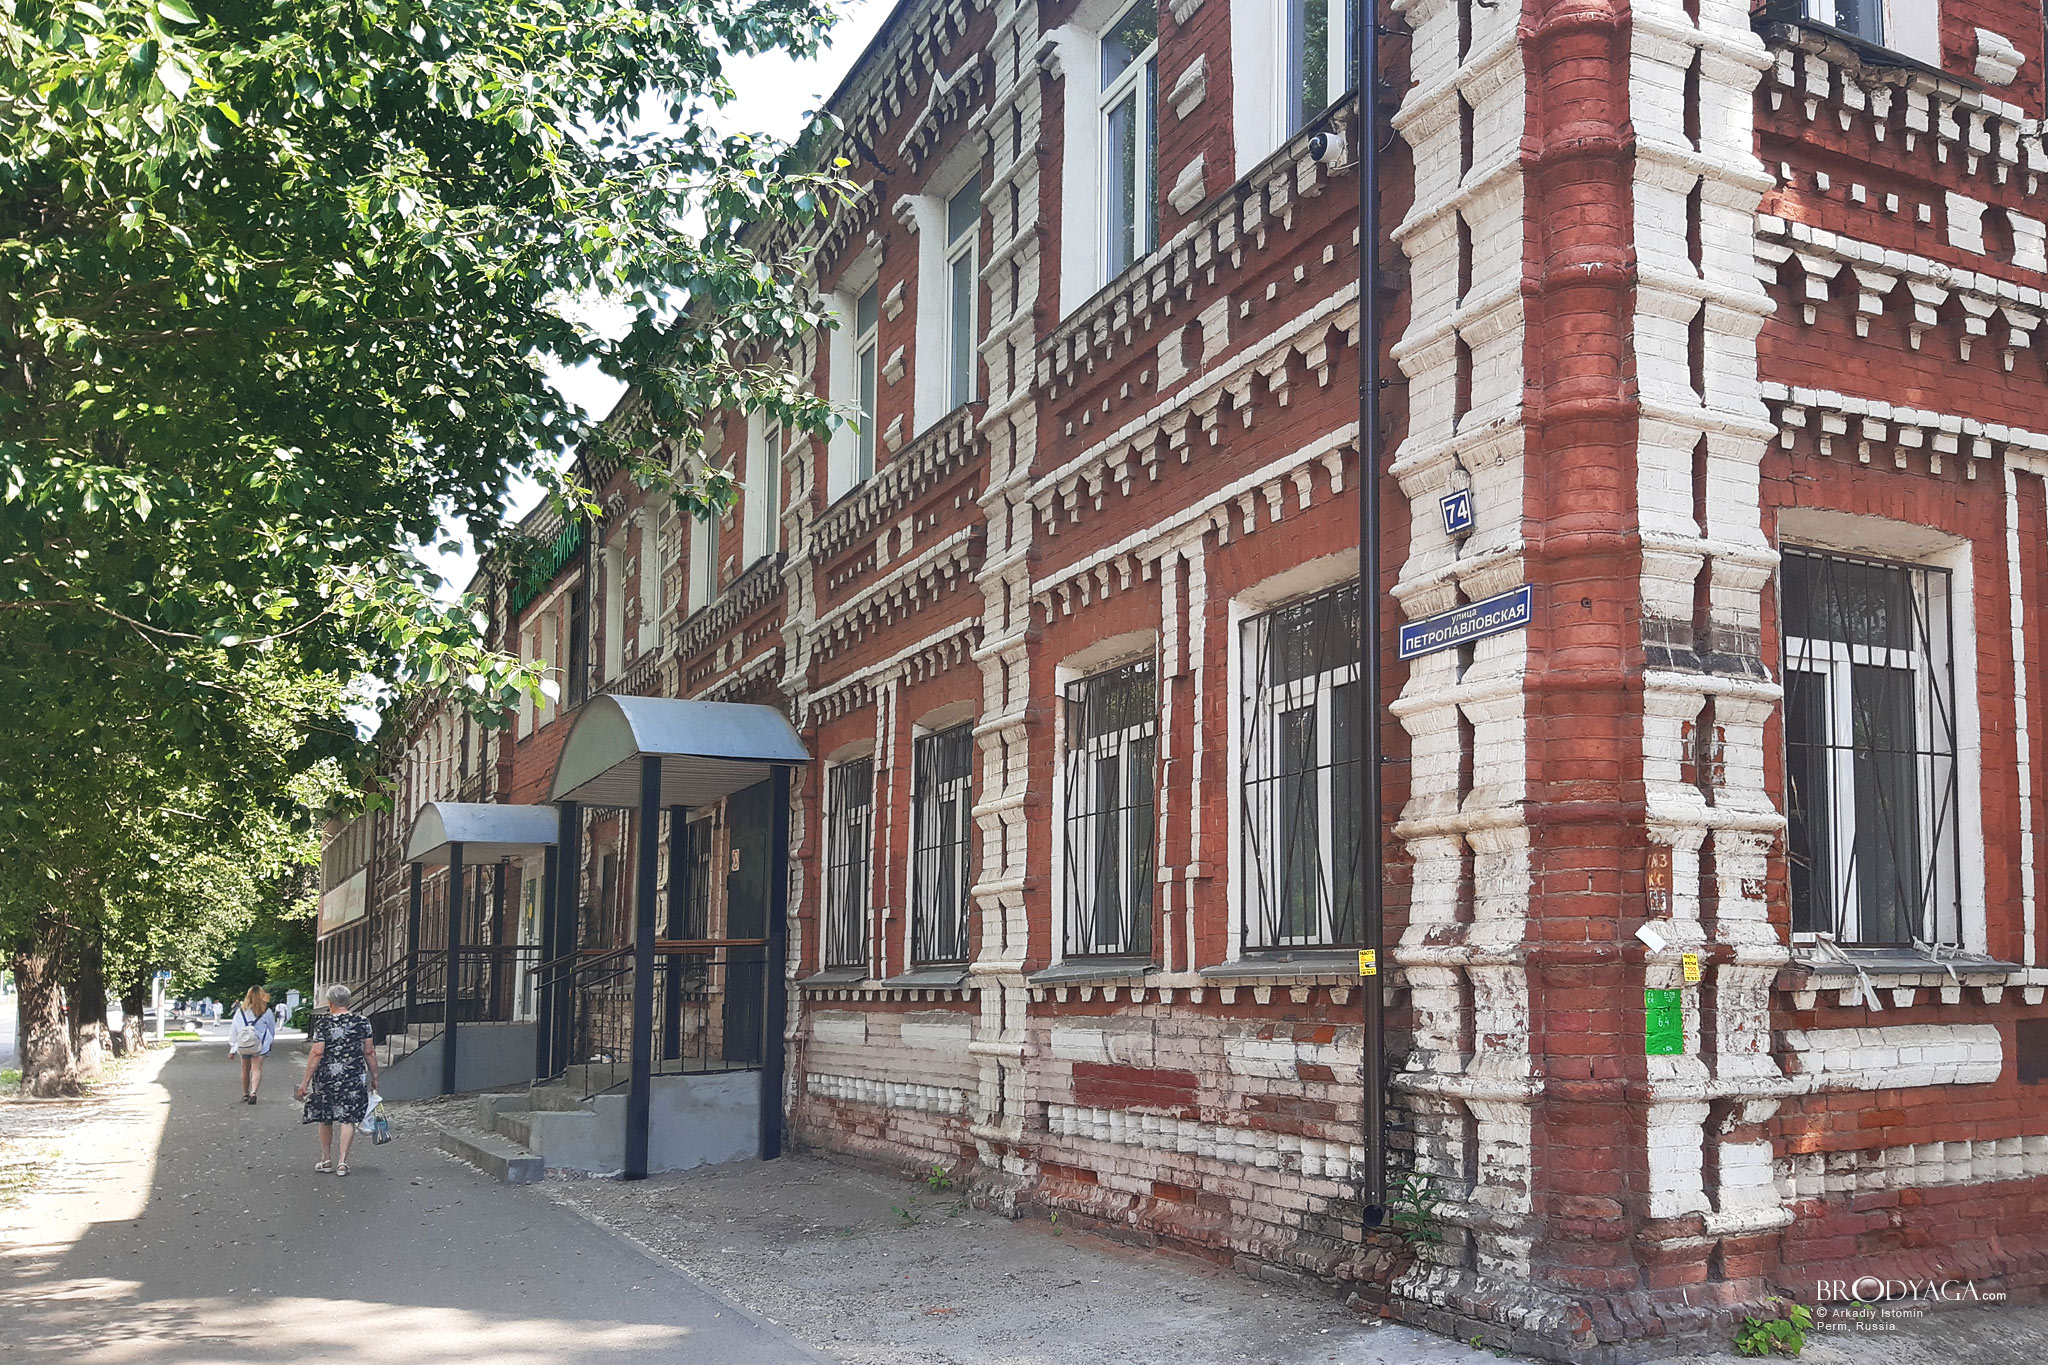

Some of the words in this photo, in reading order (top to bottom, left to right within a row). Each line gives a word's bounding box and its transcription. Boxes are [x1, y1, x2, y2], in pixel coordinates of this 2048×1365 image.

[1445, 499, 1468, 524] 74
[1405, 603, 1525, 651] ПЕТРОПАВЛОВСКАЯ
[1451, 608, 1477, 624] улица
